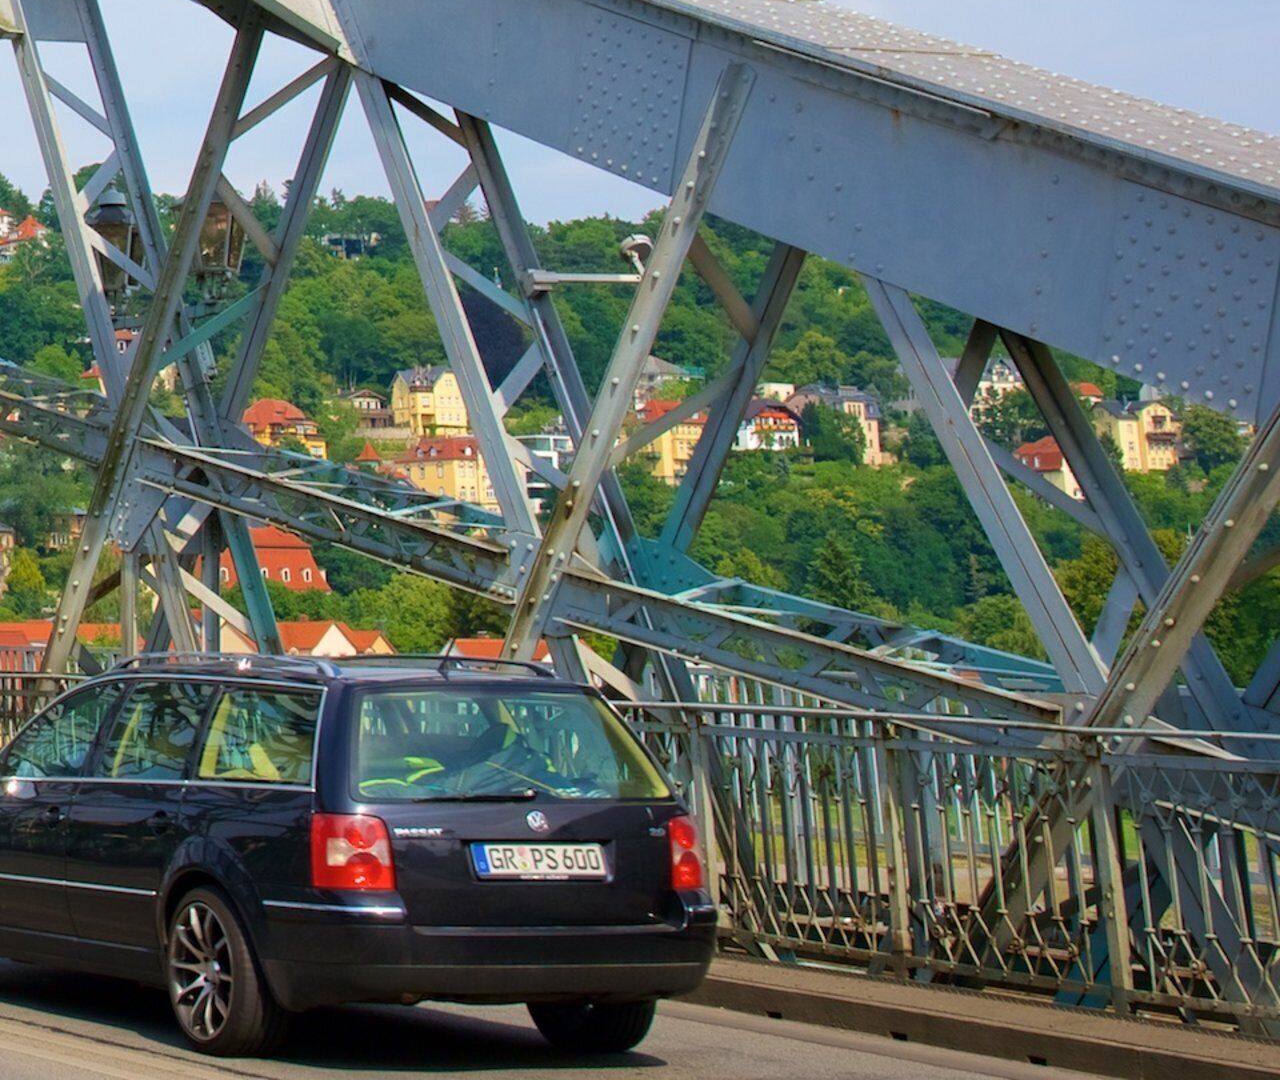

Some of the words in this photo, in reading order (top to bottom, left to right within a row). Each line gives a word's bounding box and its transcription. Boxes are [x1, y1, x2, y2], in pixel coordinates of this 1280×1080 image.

[488, 847, 519, 870] GR
[530, 847, 559, 870] PS
[562, 848, 601, 870] 600
